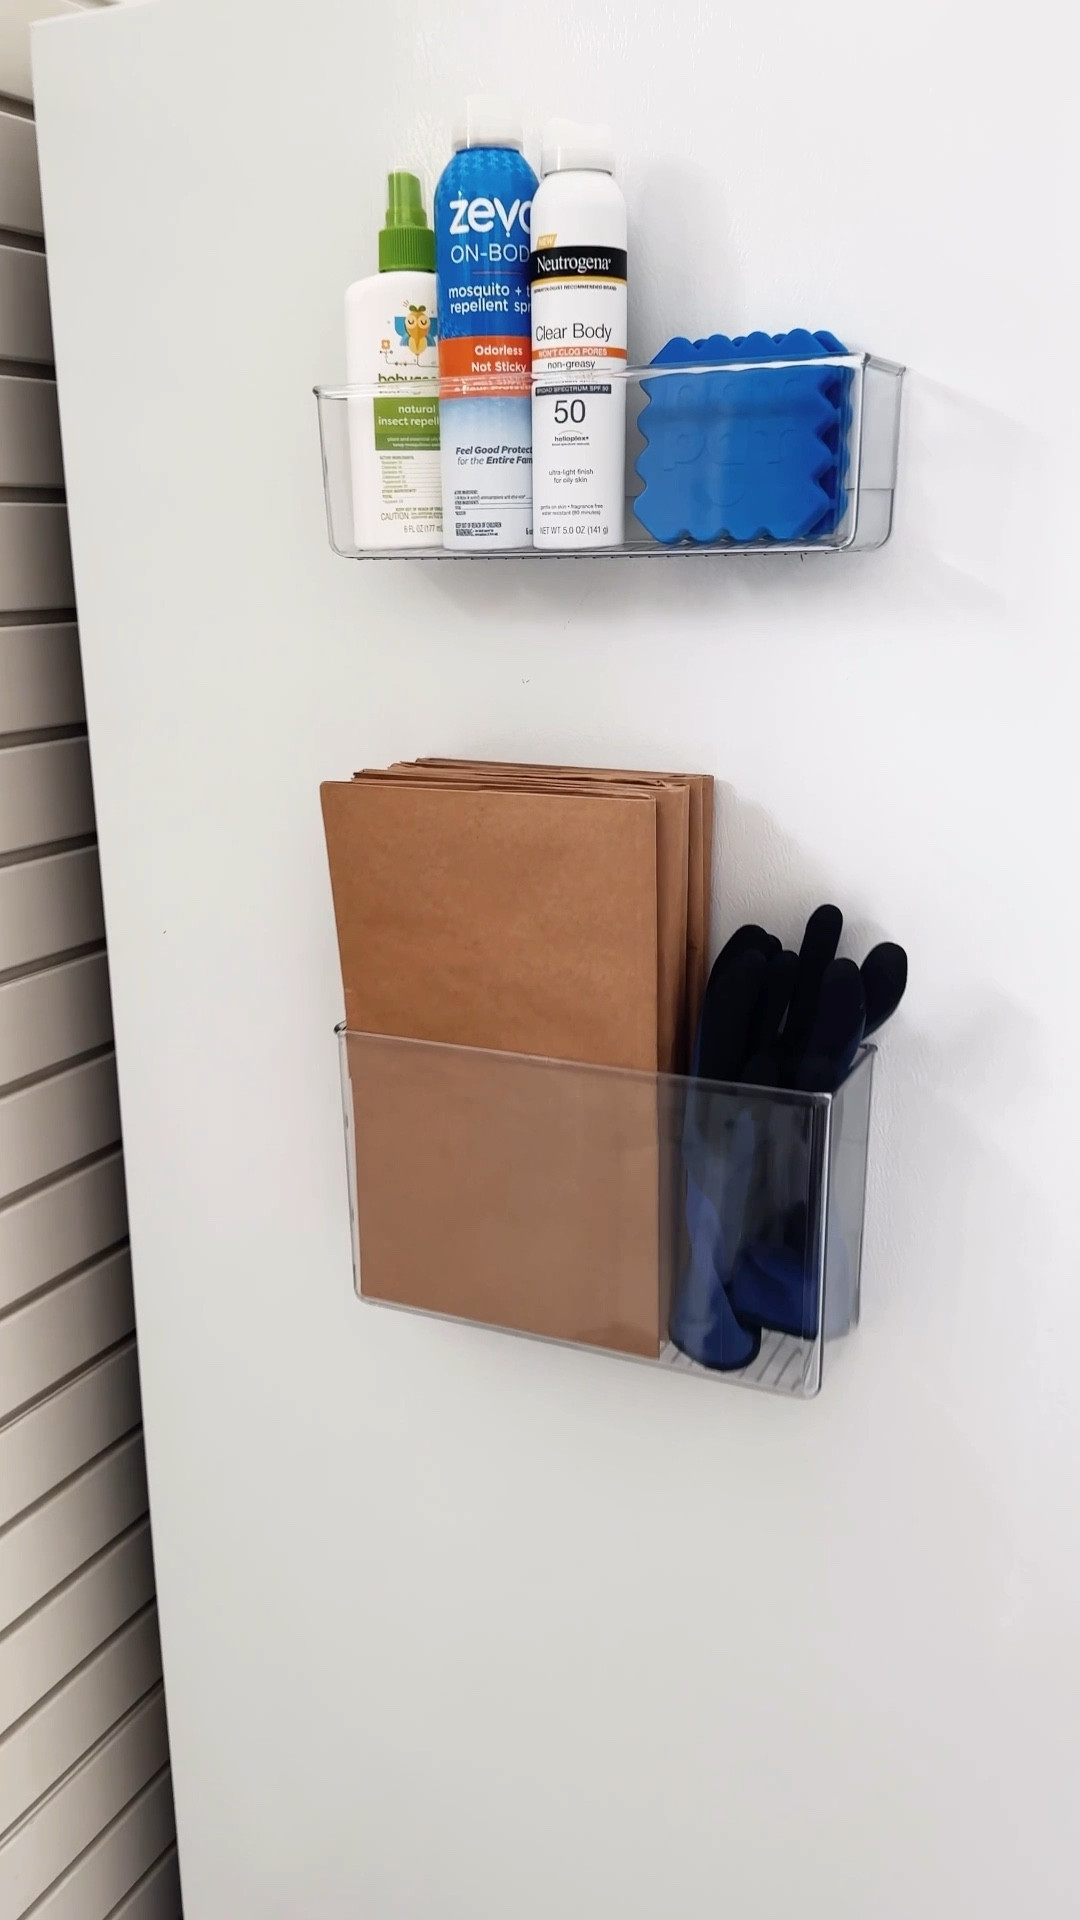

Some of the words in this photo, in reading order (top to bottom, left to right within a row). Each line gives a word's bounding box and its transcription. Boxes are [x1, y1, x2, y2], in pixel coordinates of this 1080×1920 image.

[450, 243, 530, 264] ON-BOD
[537, 257, 610, 274] Neutrogena
[449, 282, 510, 299] mosquito
[450, 298, 508, 315] repellent
[514, 301, 531, 315] spr
[536, 325, 567, 342] Clear
[573, 323, 612, 342] Body
[474, 345, 523, 356] Odorless
[558, 348, 581, 356] CLOG
[582, 347, 608, 356] PORES
[471, 362, 491, 373] Not
[495, 361, 527, 374] Sticky
[547, 361, 596, 370] non-greasy
[398, 405, 436, 414] natural
[554, 399, 586, 424] 50
[378, 416, 409, 426] insect
[410, 416, 440, 428] repell
[456, 446, 473, 455] Feel
[475, 446, 500, 455] Good
[501, 445, 532, 455] Protect
[458, 457, 469, 465] for
[470, 457, 485, 465] the
[486, 456, 515, 465] Entire
[516, 456, 532, 464] Fam
[562, 477, 573, 485] oily
[540, 526, 550, 534] NET
[550, 526, 561, 534] WT
[562, 526, 574, 535] 5.0
[575, 526, 586, 534] OZ
[587, 526, 601, 535] (141
[602, 525, 609, 535] g)
